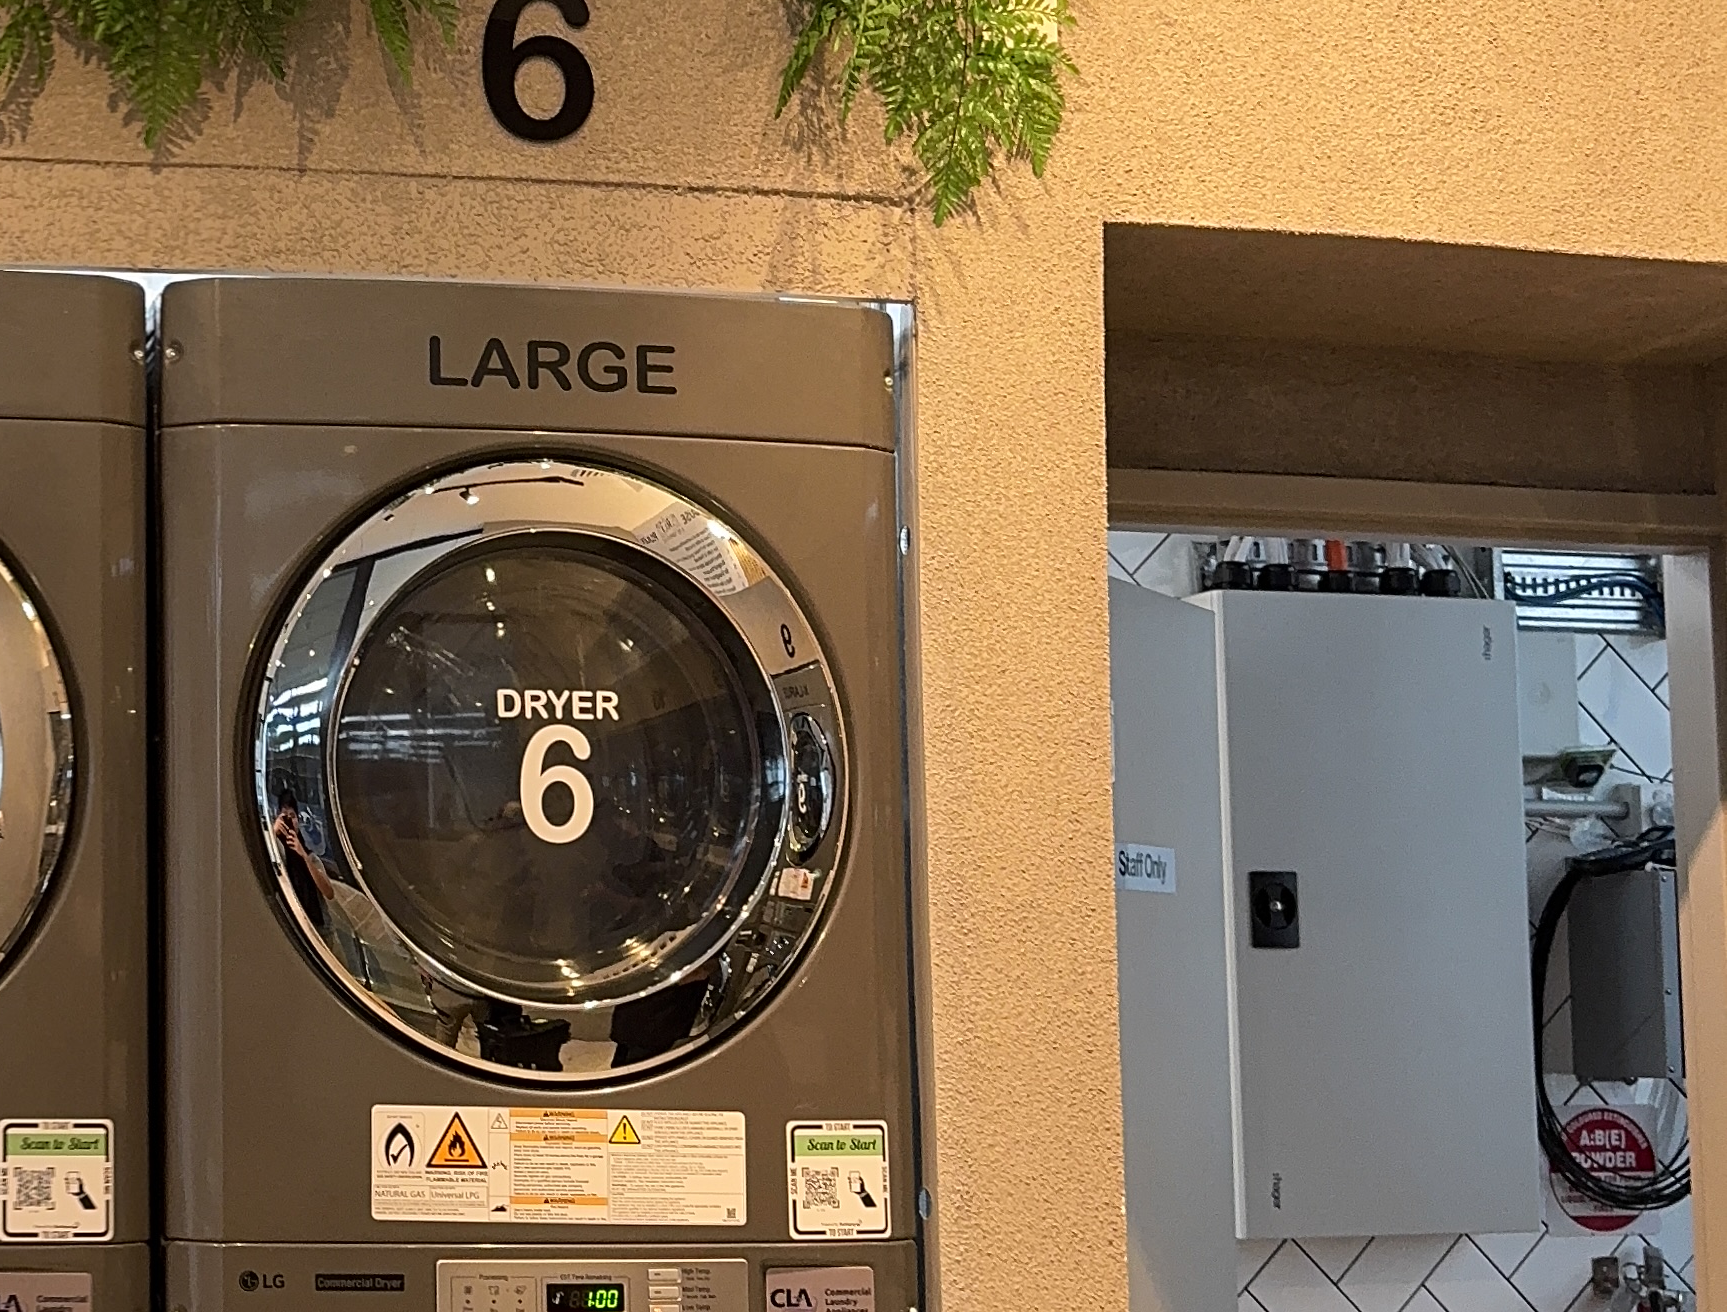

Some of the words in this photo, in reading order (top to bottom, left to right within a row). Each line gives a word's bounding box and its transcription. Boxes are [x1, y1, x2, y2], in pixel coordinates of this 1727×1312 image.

[428, 335, 678, 396] LARGE
[496, 688, 619, 722] DRYER
[517, 725, 595, 843] 6
[1118, 850, 1144, 877] Staff
[1145, 853, 1167, 885] Only
[20, 1136, 51, 1150] Scan
[53, 1139, 65, 1150] to
[68, 1137, 99, 1150] Start
[807, 1138, 834, 1151] Scan
[836, 1139, 846, 1150] to
[849, 1137, 877, 1151] Start
[263, 1274, 285, 1288] LG
[317, 1276, 373, 1288] Commercial
[375, 1277, 402, 1289] Dryer
[770, 1288, 812, 1308] CLA
[825, 1287, 871, 1296] Commercial
[825, 1298, 858, 1306] Laundry
